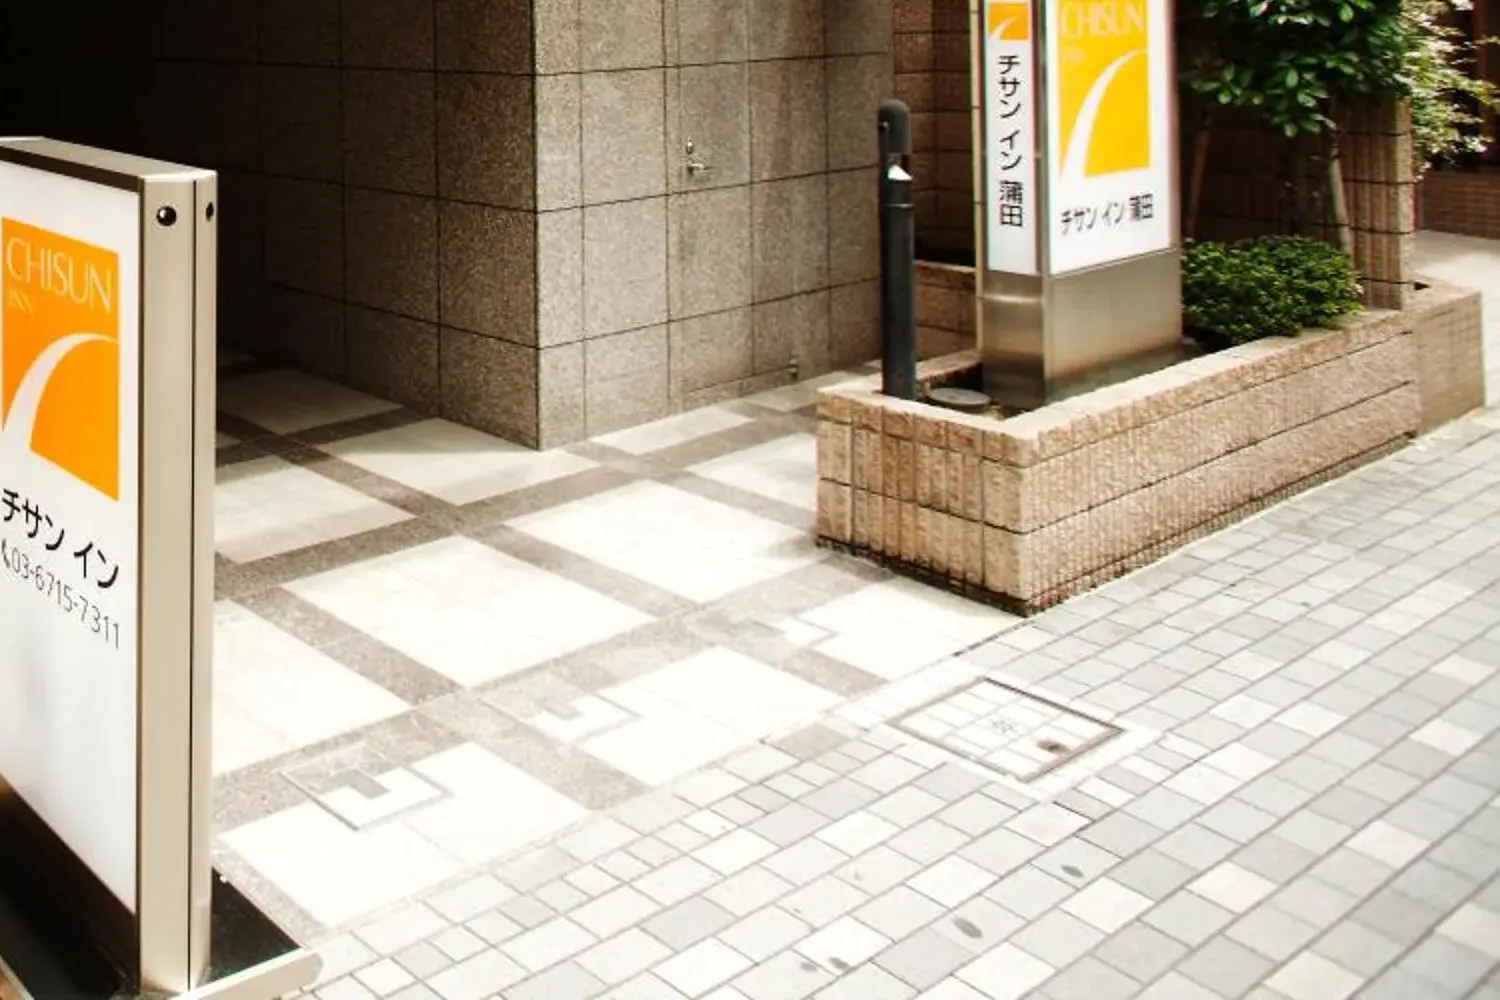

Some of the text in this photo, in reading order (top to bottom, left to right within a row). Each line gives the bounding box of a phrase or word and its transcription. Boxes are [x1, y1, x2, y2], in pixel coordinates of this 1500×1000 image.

[998, 55, 1021, 120] チサン
[999, 130, 1023, 171] イン
[6, 237, 113, 314] CHISUN
[1, 488, 120, 589] チサン イン
[11, 547, 120, 650] 03-6715-7311
